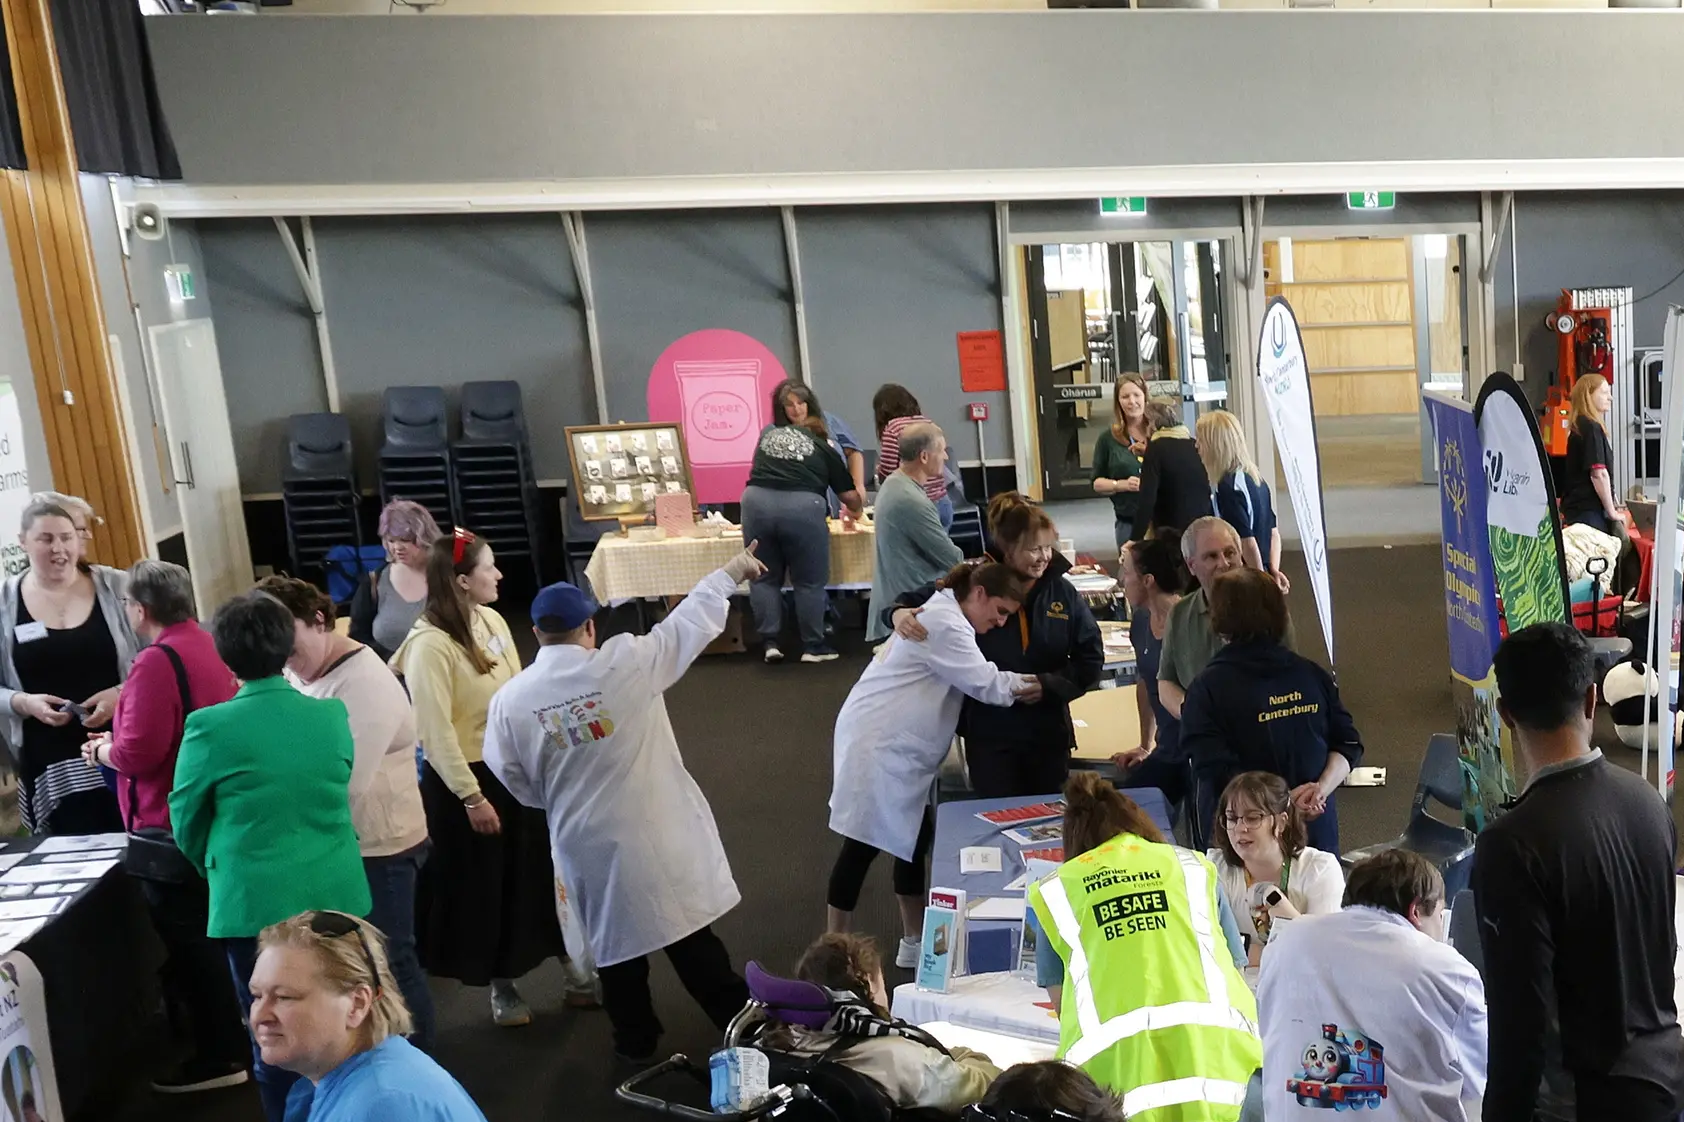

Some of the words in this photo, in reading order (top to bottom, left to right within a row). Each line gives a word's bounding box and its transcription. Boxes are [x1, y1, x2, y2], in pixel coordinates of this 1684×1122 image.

[702, 403, 743, 416] Paper
[704, 420, 733, 430] Jam.
[1503, 480, 1519, 496] Lib
[1446, 543, 1477, 575] Special
[1269, 691, 1302, 706] North
[1258, 703, 1319, 722] Canterbury
[1082, 868, 1128, 884] Rayonier
[1085, 870, 1161, 894] matariki
[1099, 901, 1120, 921] BE
[1121, 893, 1163, 914] SAFE
[1104, 923, 1125, 941] BE
[1127, 915, 1166, 935] SEEN
